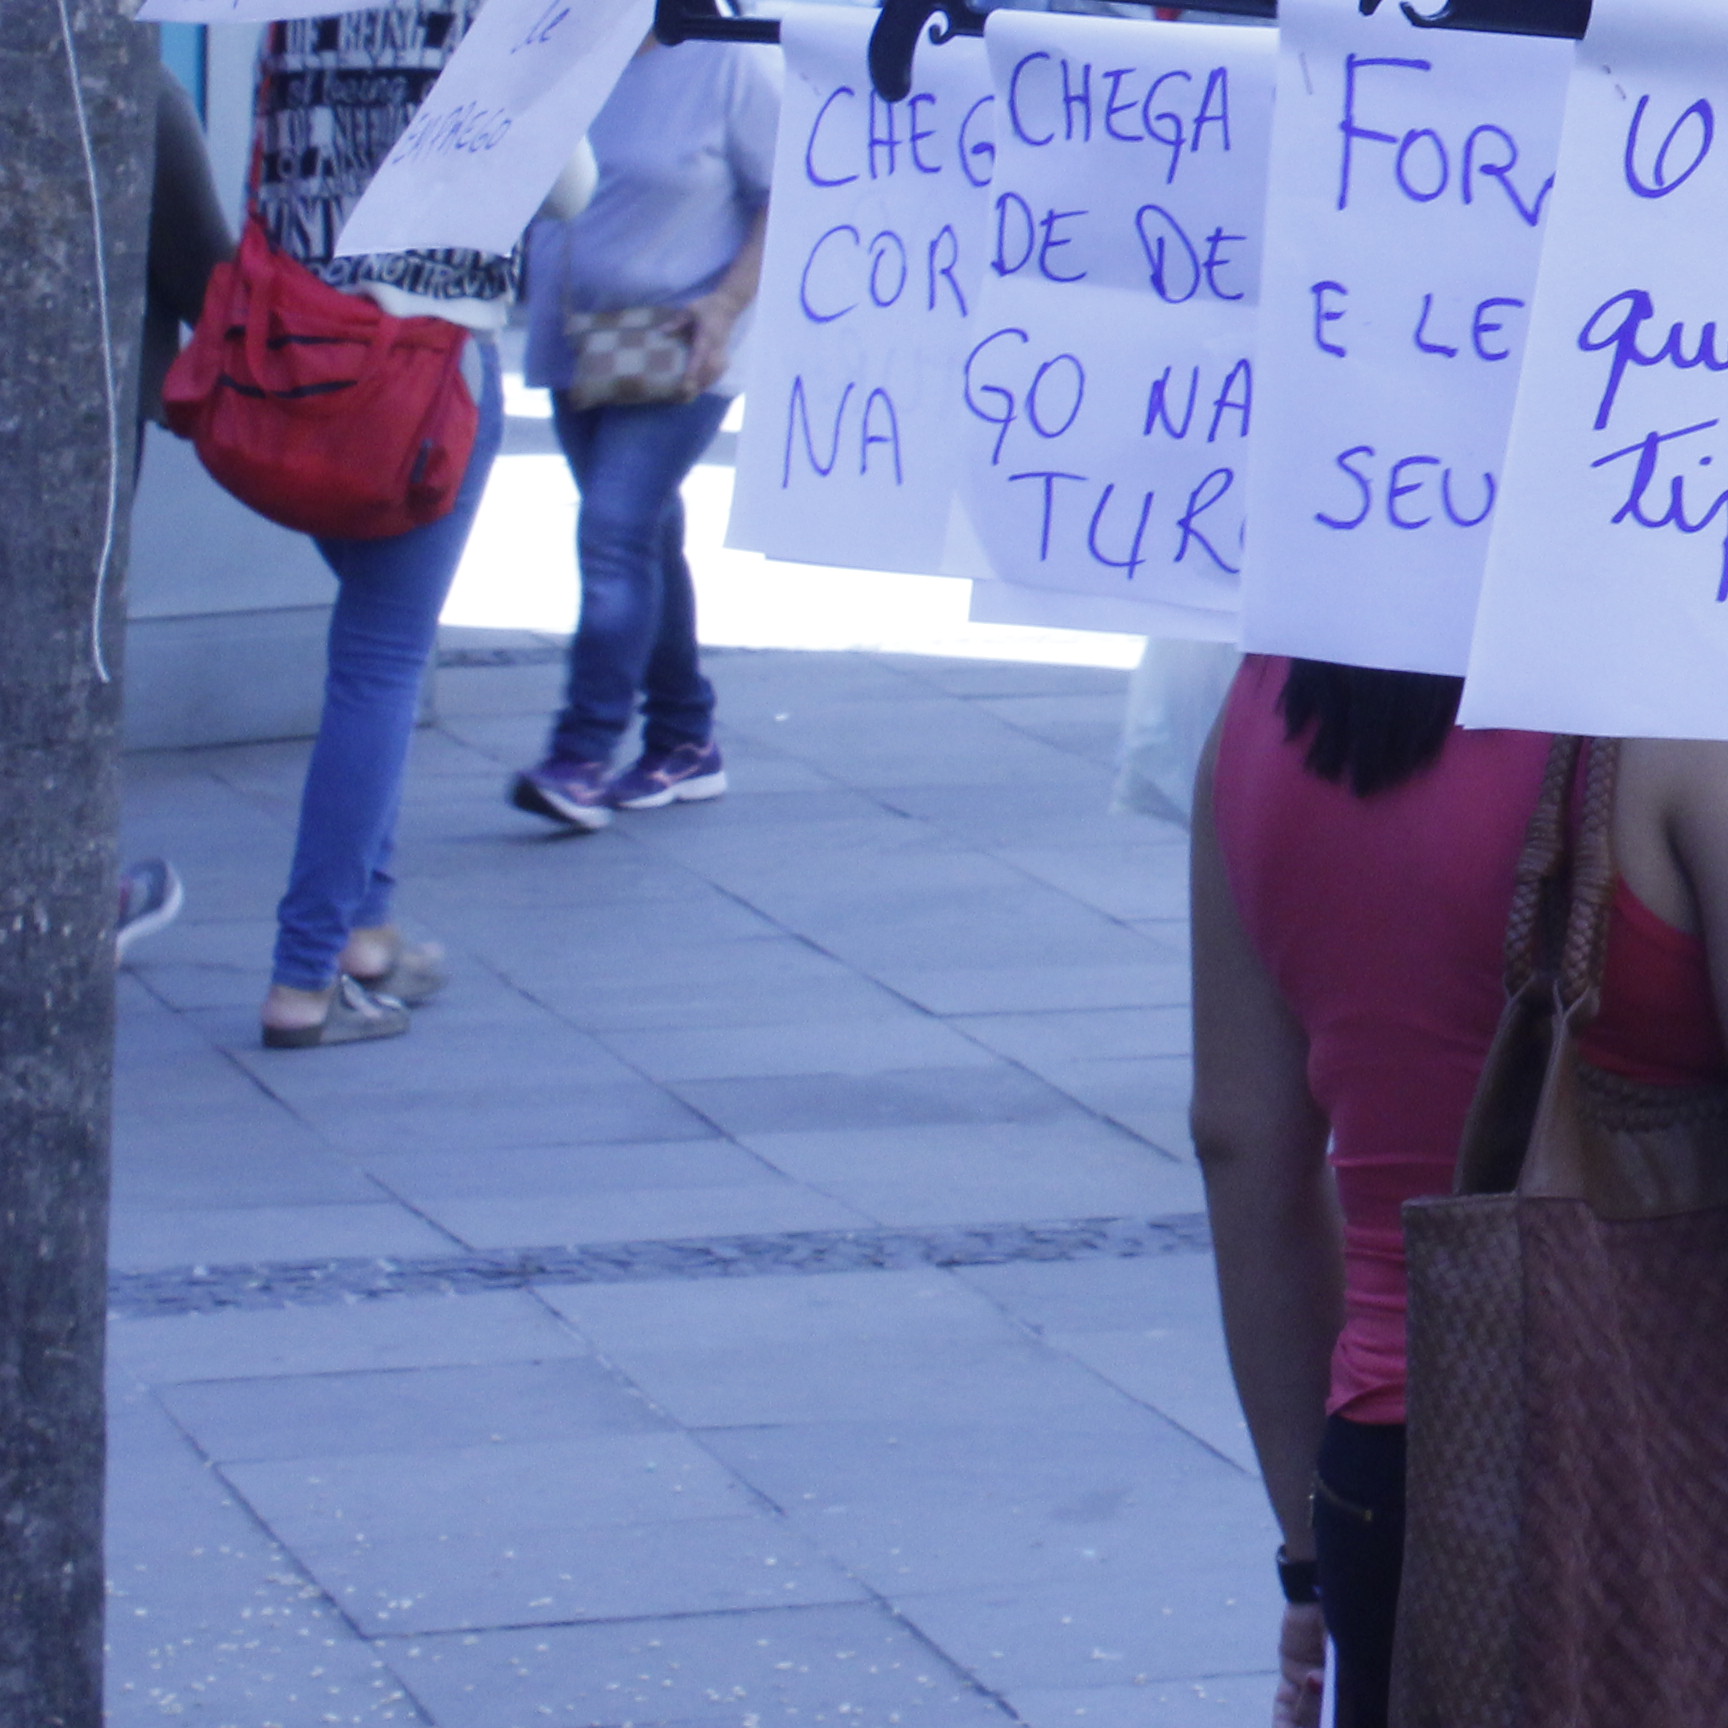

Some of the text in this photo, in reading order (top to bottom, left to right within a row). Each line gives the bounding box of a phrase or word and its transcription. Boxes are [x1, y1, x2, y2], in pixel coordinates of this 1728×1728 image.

[1008, 51, 1230, 184] CHEGA
[991, 192, 1088, 282] DE
[783, 375, 902, 489] NA
